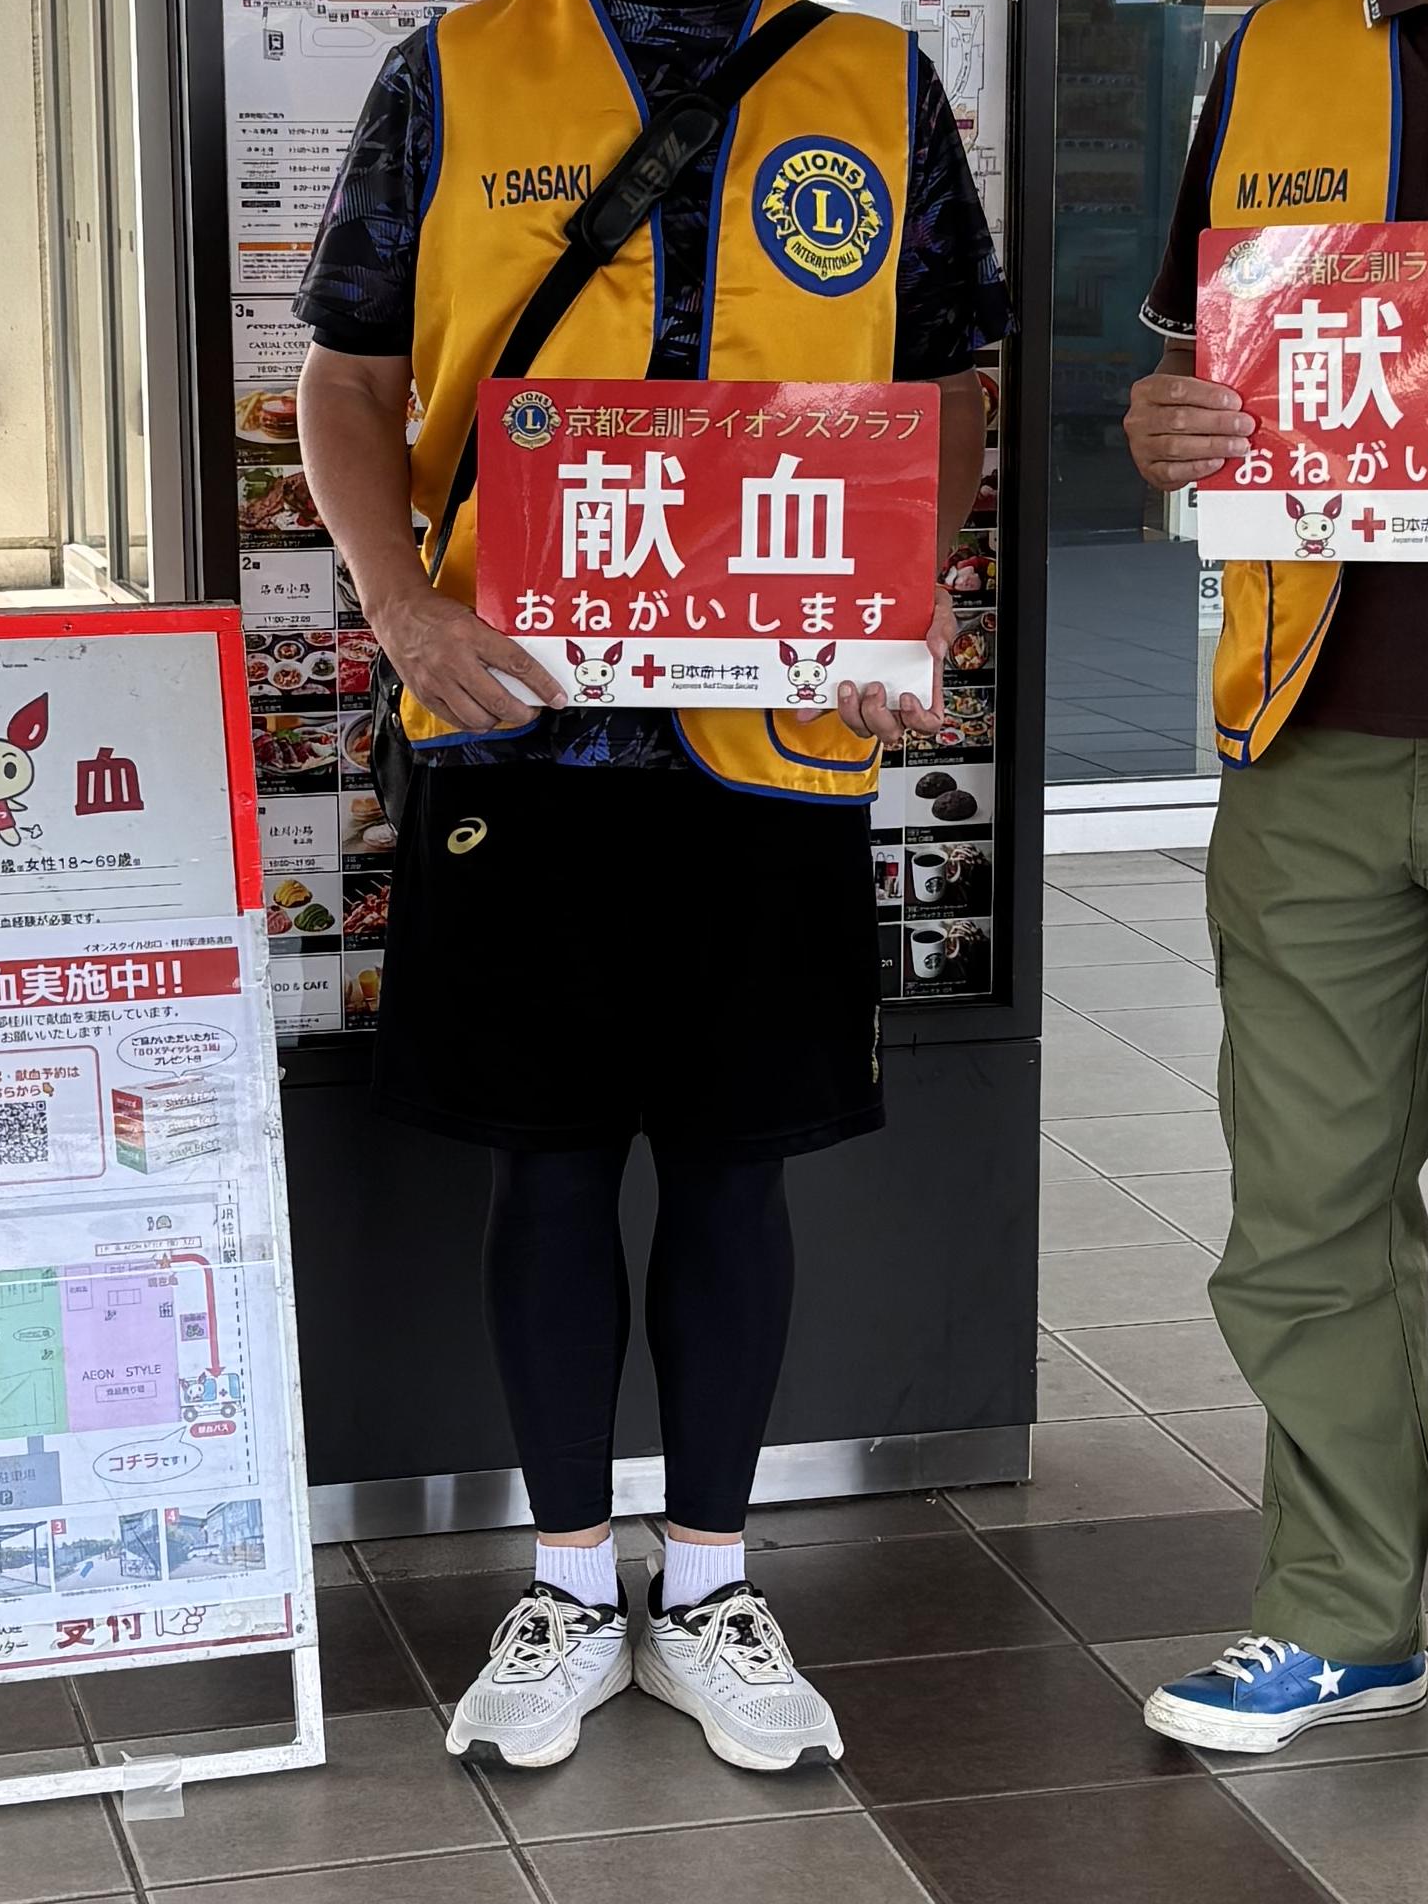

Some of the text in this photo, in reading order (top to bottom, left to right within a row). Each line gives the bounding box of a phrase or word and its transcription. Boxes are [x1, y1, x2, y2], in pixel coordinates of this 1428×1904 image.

[789, 153, 861, 185] LIONS
[482, 164, 594, 210] Y.SASAKI
[1237, 167, 1348, 210] M.YASUDA
[812, 188, 843, 235] L
[791, 241, 859, 271] INTERNATIONAL
[514, 391, 554, 408] LIONS
[526, 410, 541, 430] L
[564, 405, 925, 441] 京都乙訓ライオンズクラブ
[515, 588, 897, 635] おねがいします
[671, 664, 759, 680] 日本赤十字社
[304, 980, 329, 990] CAFE
[82, 1364, 162, 1381] AEON STYLE
[54, 1521, 63, 1533] 3
[167, 1510, 177, 1521] 4
